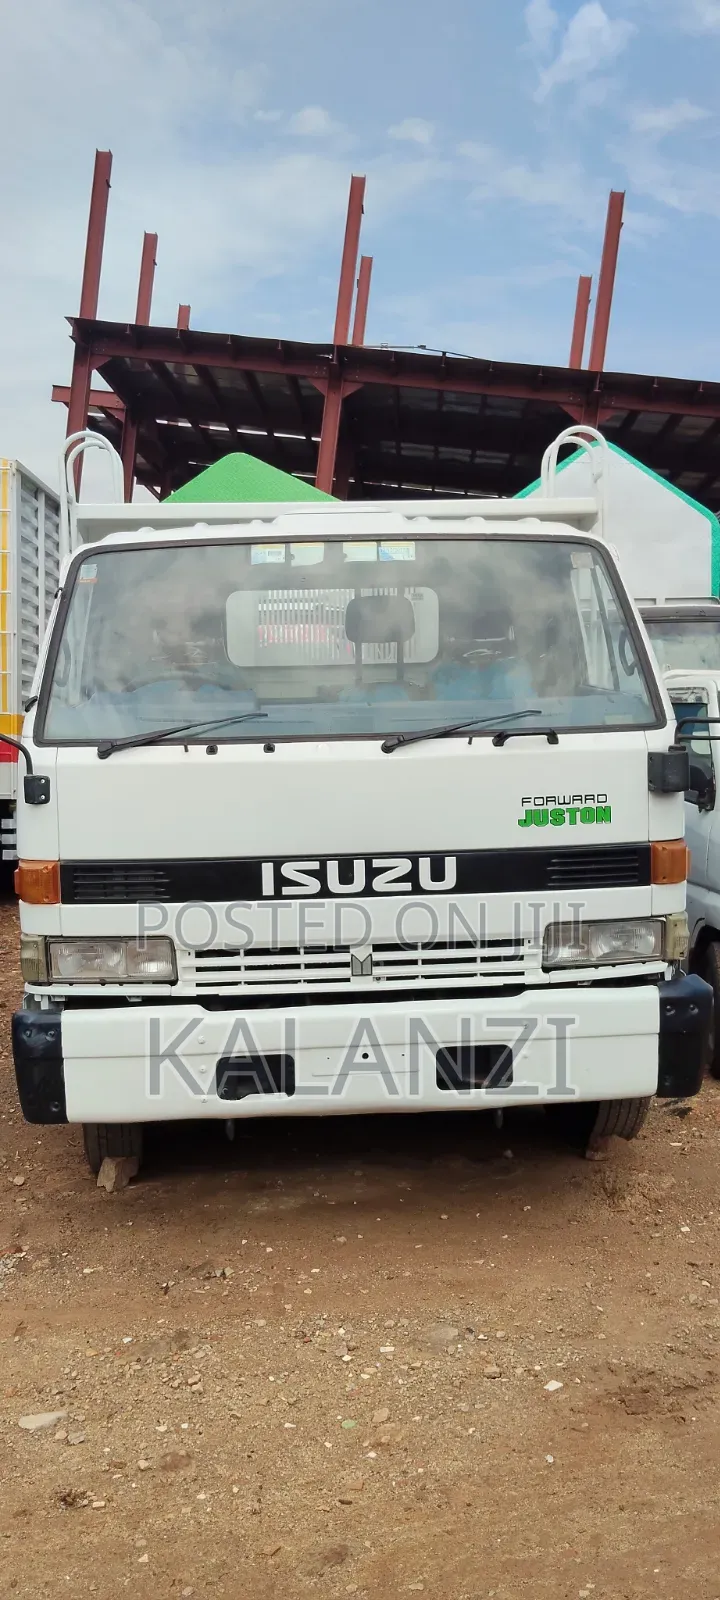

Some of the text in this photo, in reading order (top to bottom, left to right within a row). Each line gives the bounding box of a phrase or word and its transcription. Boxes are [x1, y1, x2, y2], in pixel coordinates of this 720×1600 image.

[521, 793, 608, 807] FORWARD
[518, 805, 612, 828] JUSTON
[261, 857, 457, 897] ISUZU
